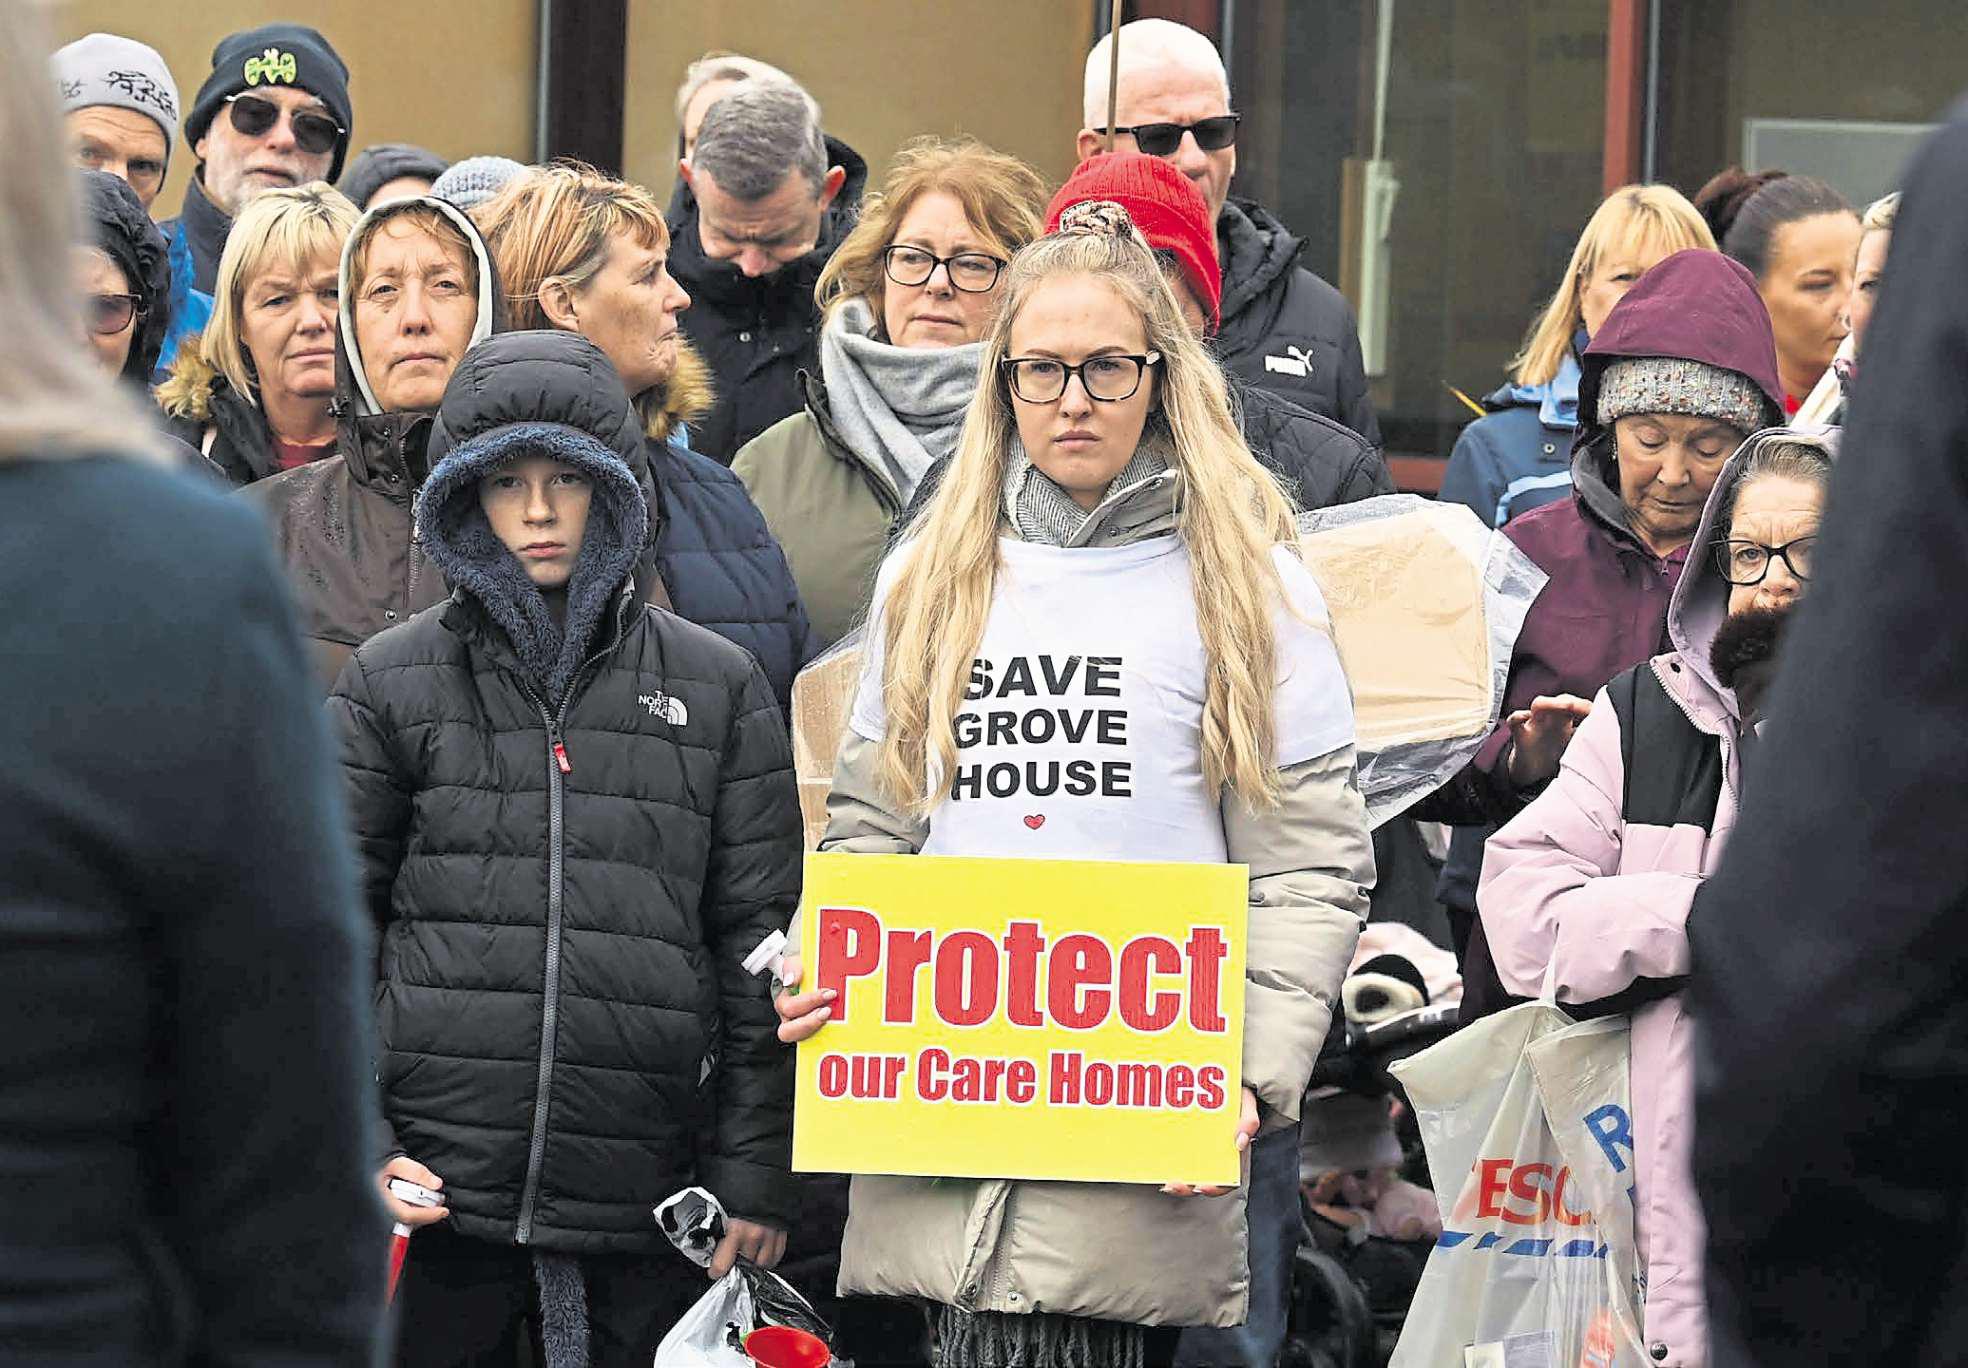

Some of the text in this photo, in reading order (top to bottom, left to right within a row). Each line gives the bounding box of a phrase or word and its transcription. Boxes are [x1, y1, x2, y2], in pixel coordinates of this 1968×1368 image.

[963, 655, 1123, 700] SAVE
[952, 708, 1128, 749] GROVE
[950, 760, 1132, 801] HOUSE
[817, 908, 1228, 1033] Protect
[819, 1048, 1225, 1110] our Care Homes
